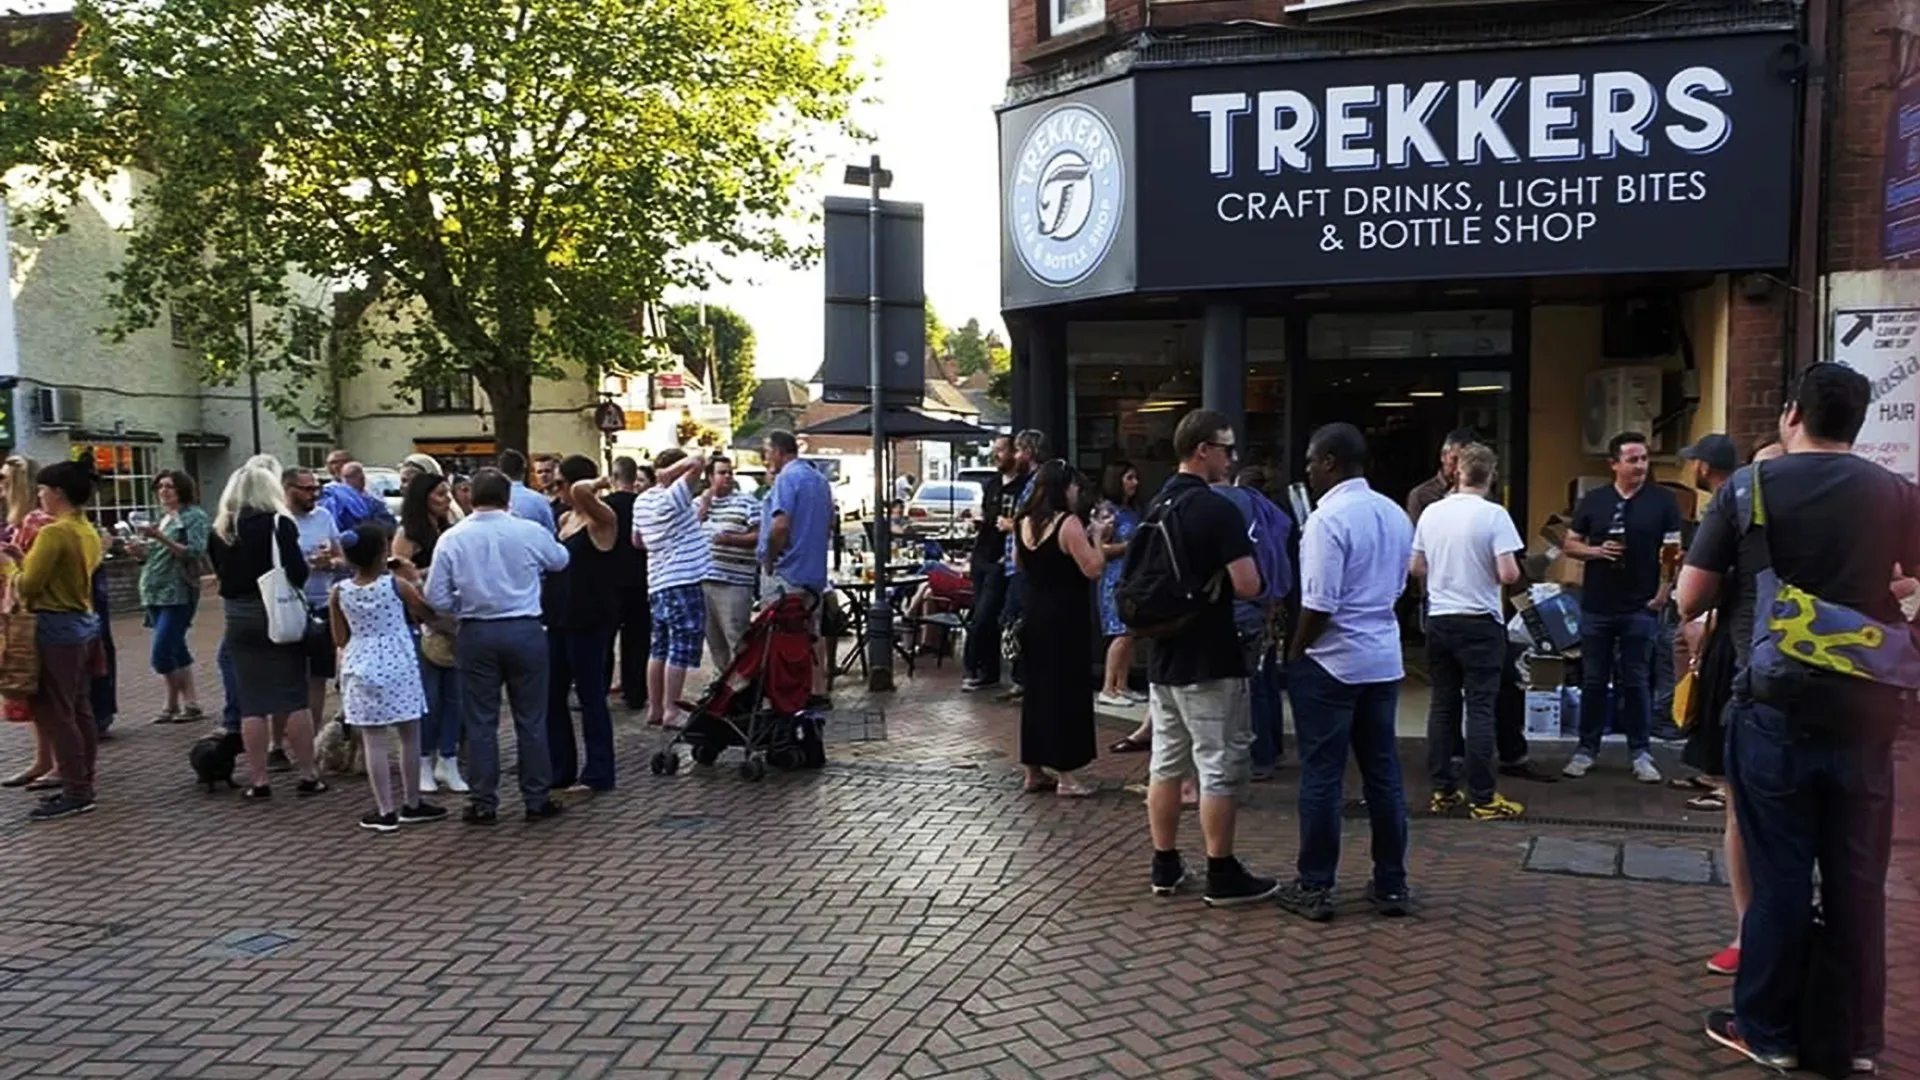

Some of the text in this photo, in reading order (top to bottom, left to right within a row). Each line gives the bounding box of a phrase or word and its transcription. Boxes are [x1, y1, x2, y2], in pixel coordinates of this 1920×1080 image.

[1191, 66, 1732, 178] TREKKERS
[1016, 114, 1111, 188] TREKKERS
[1216, 170, 1707, 223] CRAFT DRINKS, LIGHT BITES
[1088, 198, 1112, 247] SHOP
[1319, 211, 1598, 252] & BOTTLE SHOP
[1879, 402, 1915, 421] HAIR
